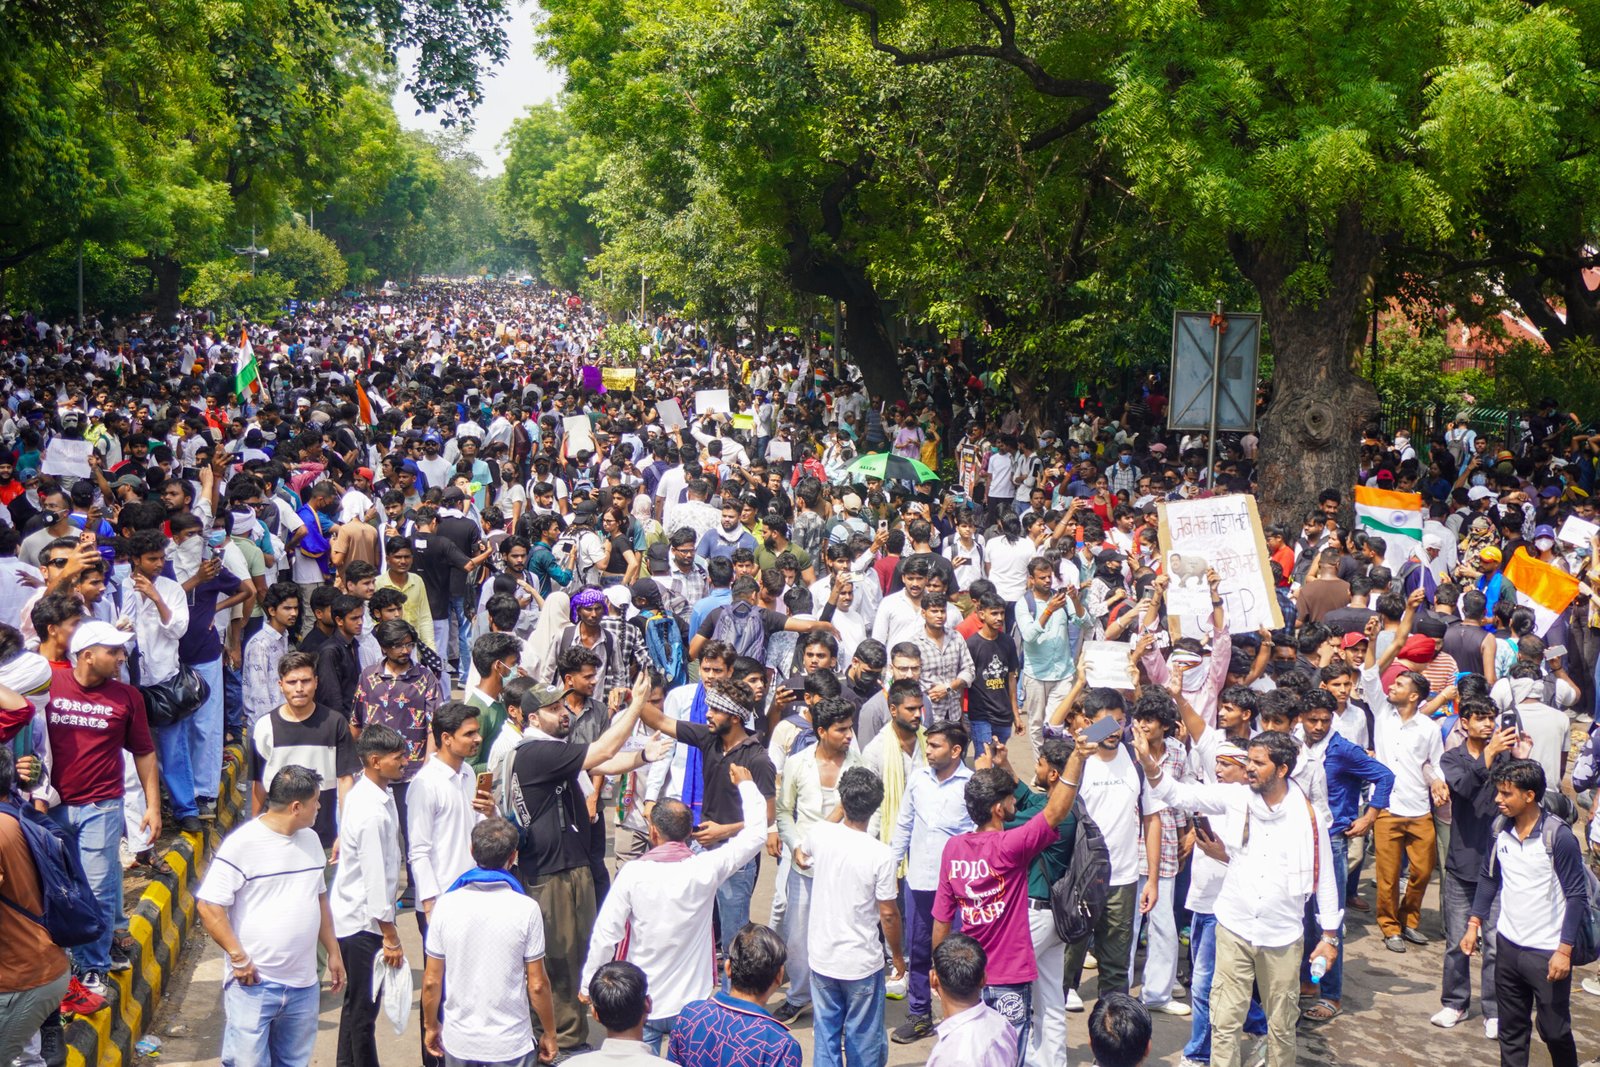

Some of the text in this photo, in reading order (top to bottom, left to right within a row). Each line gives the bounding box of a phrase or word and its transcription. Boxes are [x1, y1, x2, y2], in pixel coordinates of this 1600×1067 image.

[53, 698, 114, 716] CHROME
[50, 712, 109, 729] HEARTS
[950, 859, 990, 880] POLO
